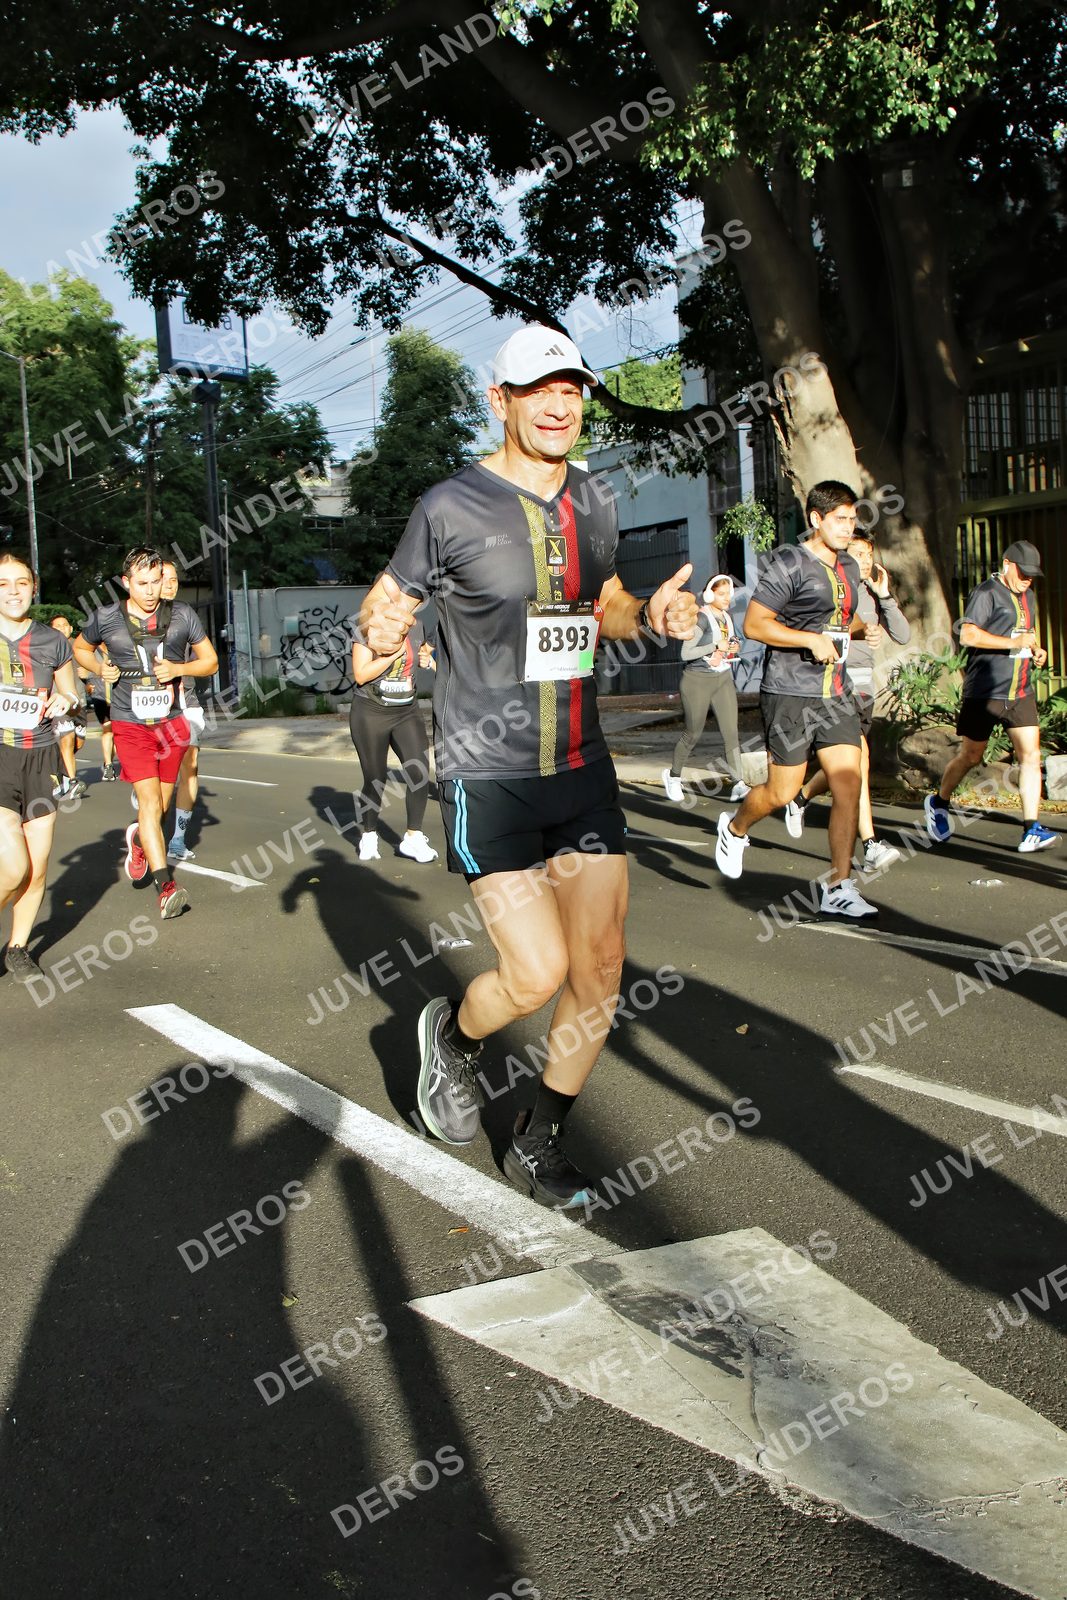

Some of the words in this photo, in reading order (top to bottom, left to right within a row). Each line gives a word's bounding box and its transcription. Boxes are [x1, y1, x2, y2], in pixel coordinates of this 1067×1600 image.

[299, 604, 338, 620] TOY
[538, 626, 590, 652] 8393
[2, 697, 38, 715] 0499
[134, 694, 169, 706] 10990
